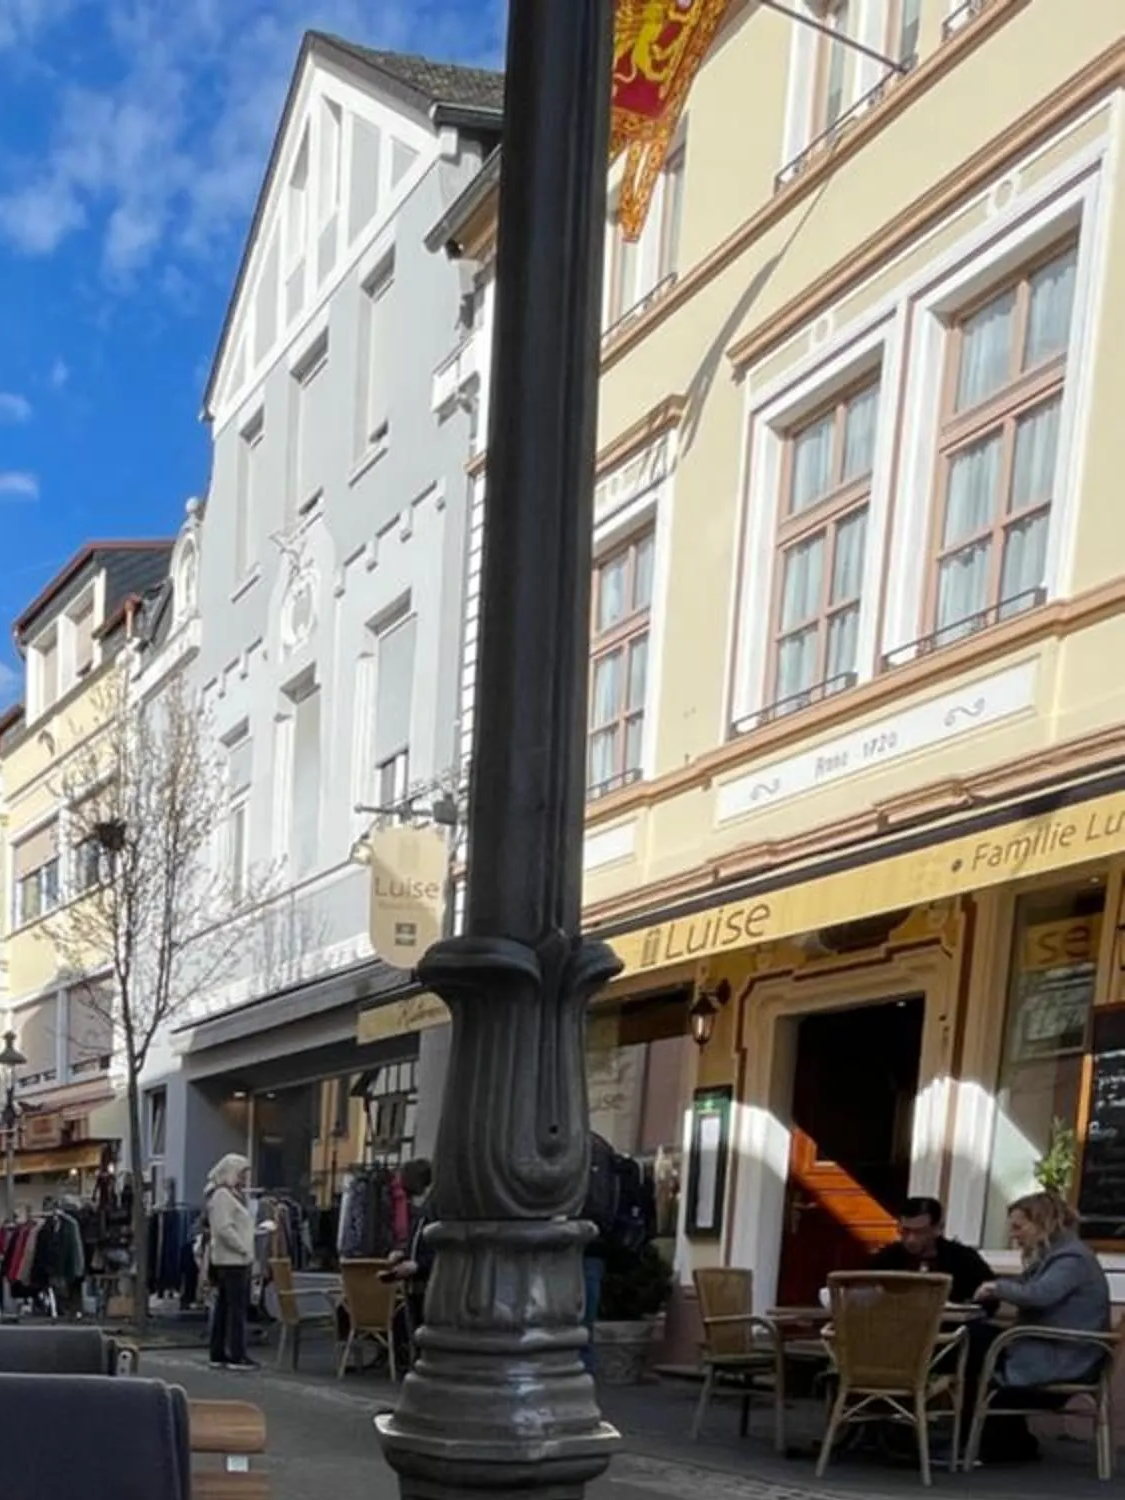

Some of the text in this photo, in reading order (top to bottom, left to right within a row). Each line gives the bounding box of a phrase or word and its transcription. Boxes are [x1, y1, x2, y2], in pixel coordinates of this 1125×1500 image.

[972, 821, 1077, 871] Familie
[375, 876, 440, 899] Luise
[665, 903, 771, 959] Luise
